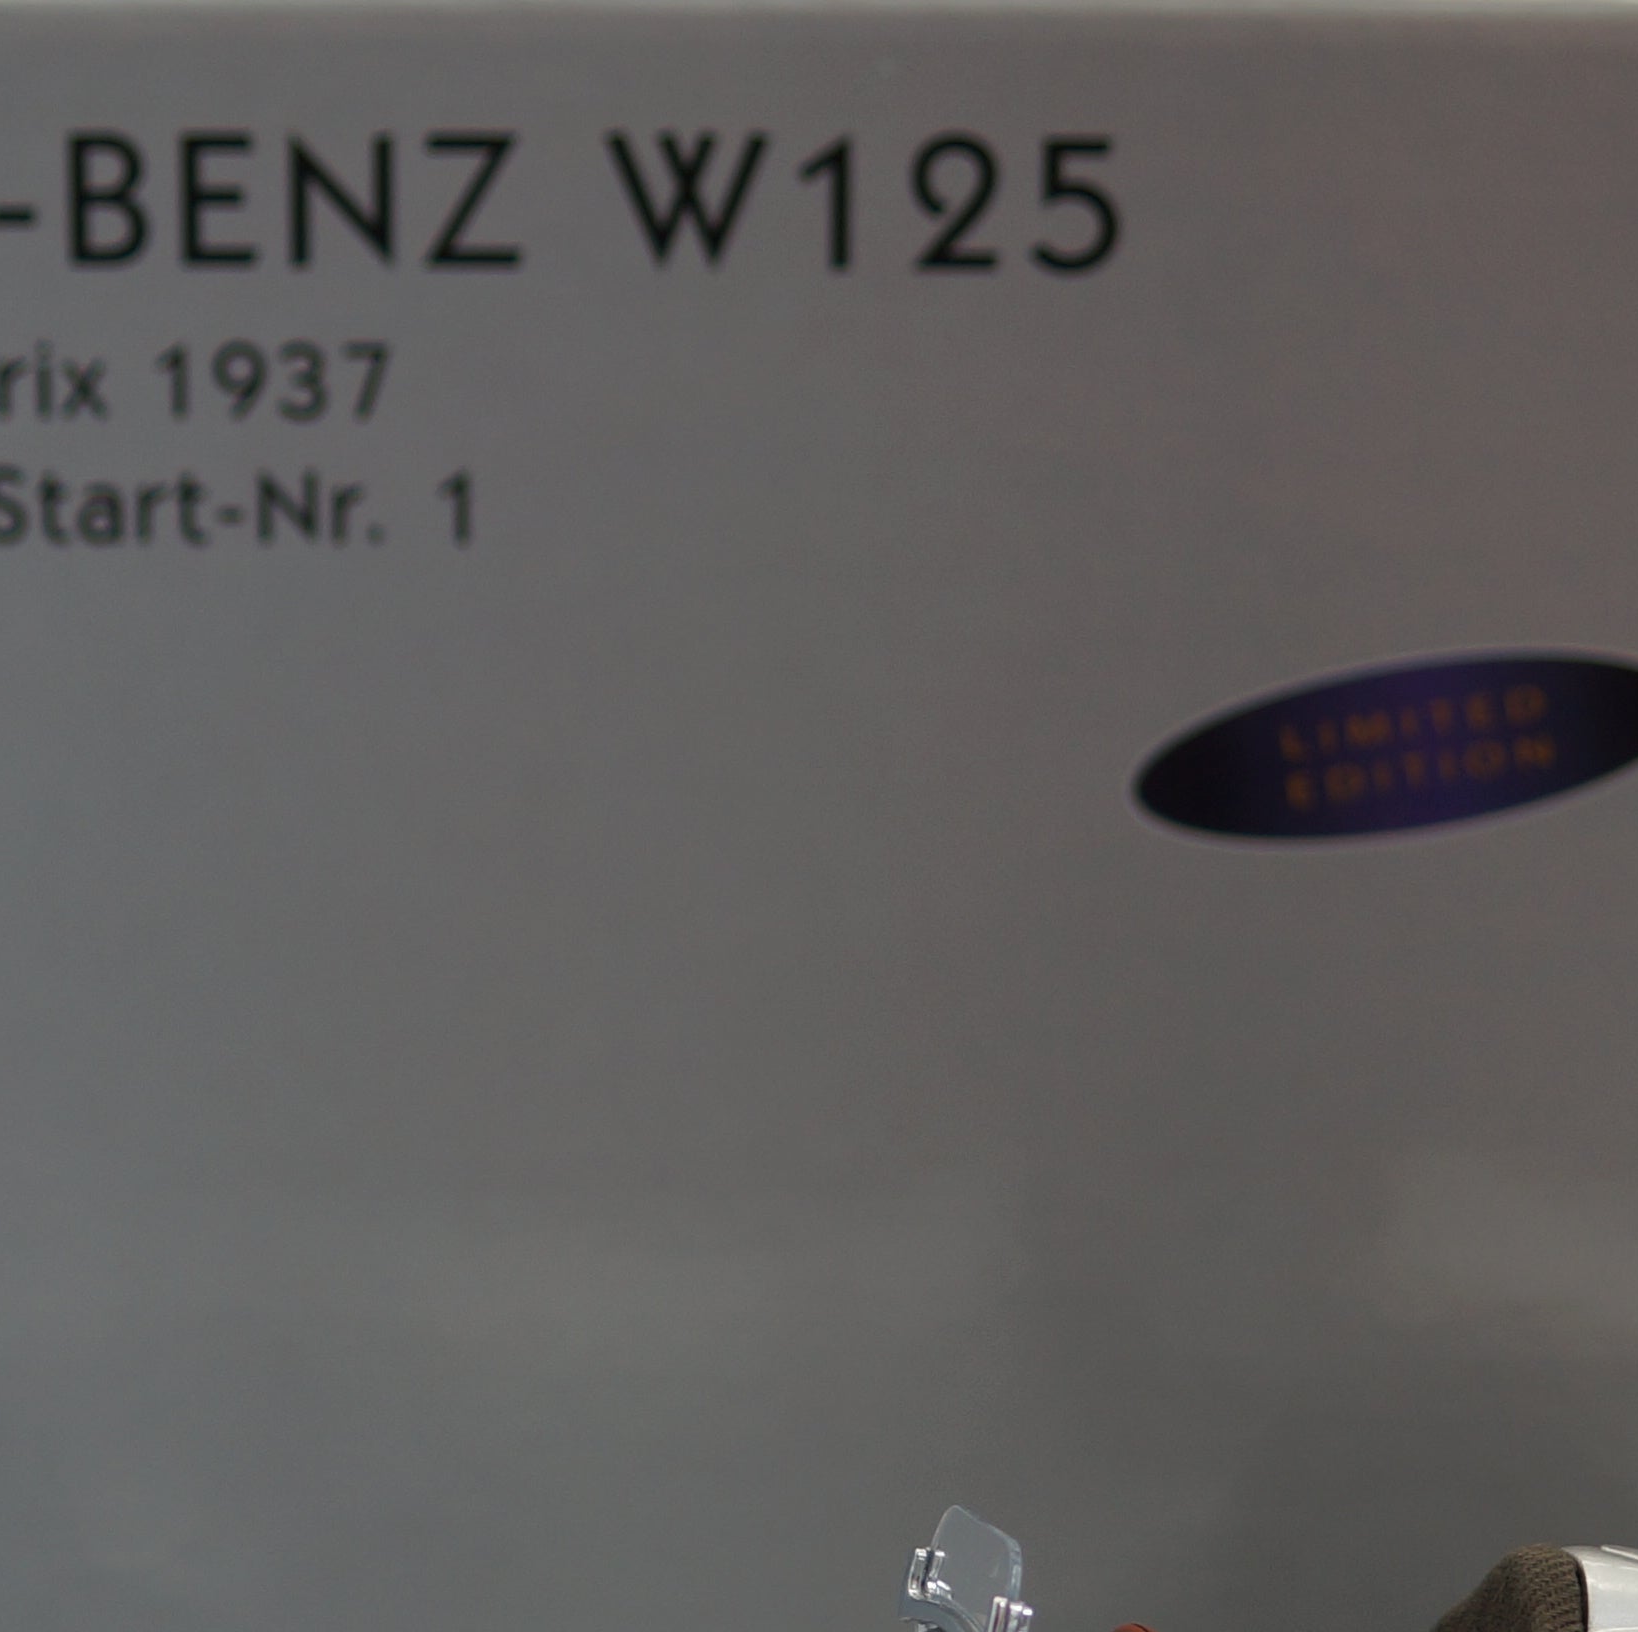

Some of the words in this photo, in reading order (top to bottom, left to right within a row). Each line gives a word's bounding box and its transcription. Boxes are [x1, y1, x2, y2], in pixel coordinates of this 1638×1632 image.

[605, 129, 1123, 278] W125
[156, 338, 392, 425] 1937
[438, 468, 476, 548] 1
[1279, 685, 1547, 764] LIMITED
[1285, 733, 1554, 811] EDITION
